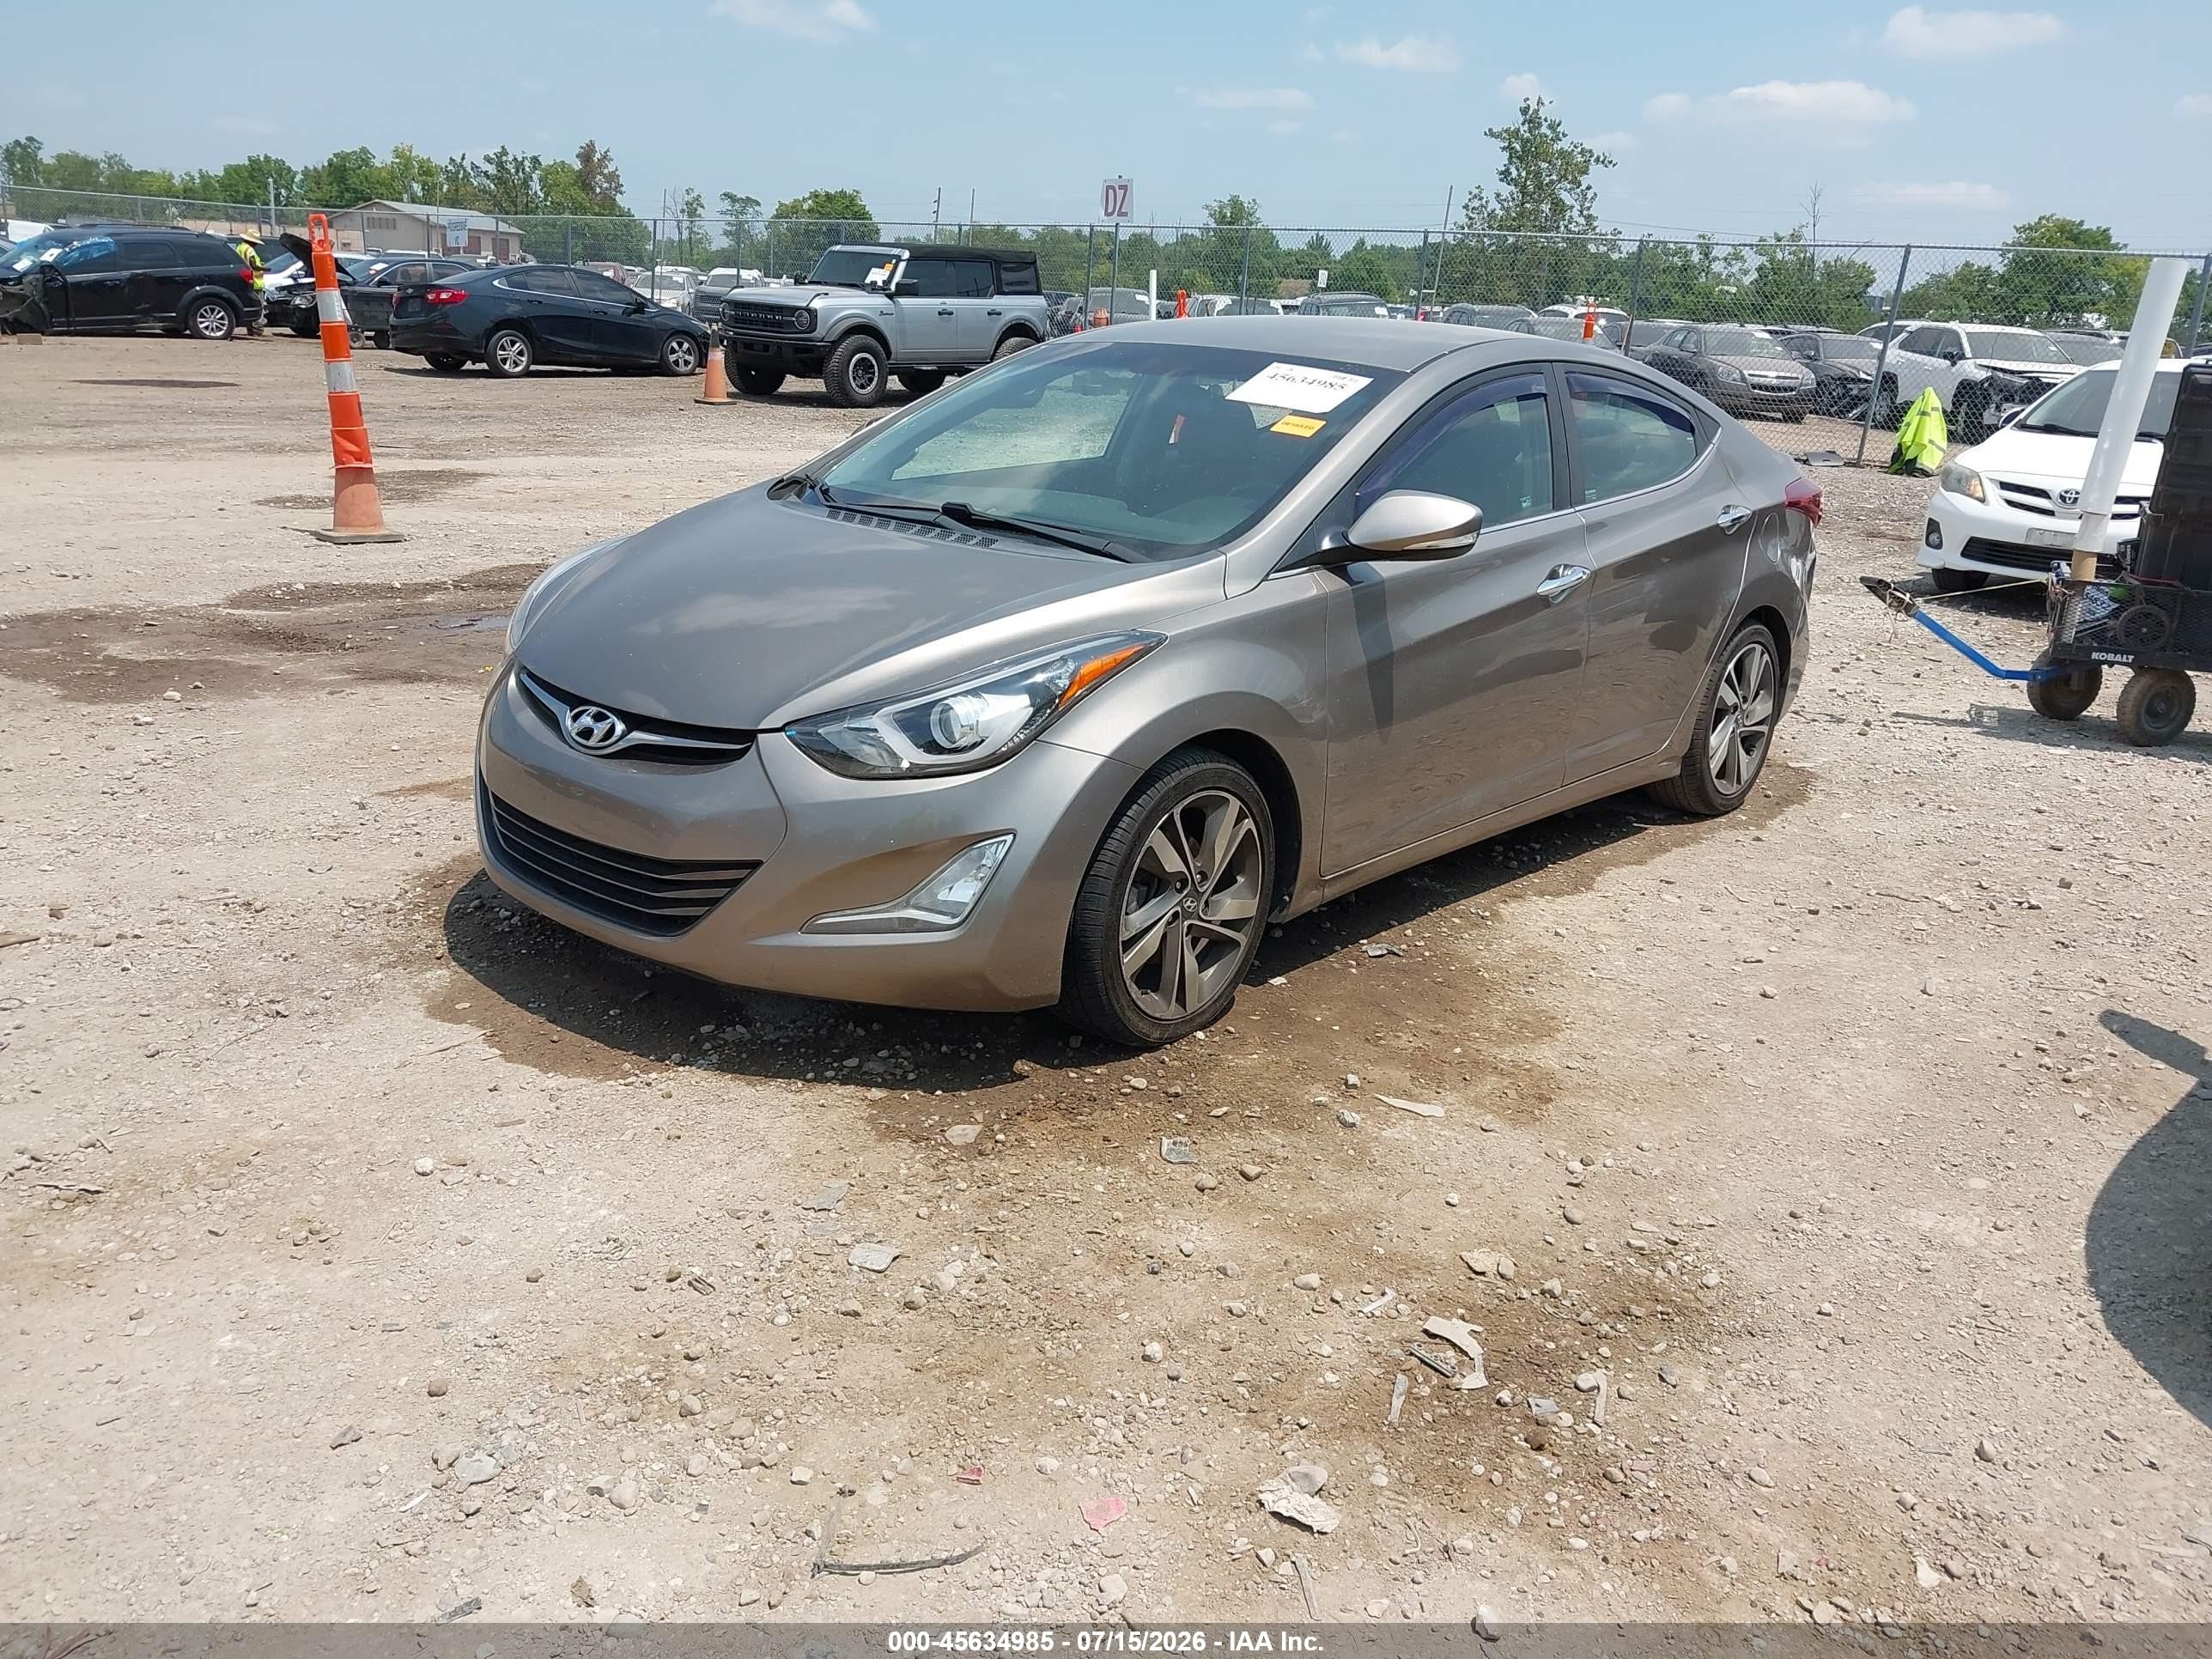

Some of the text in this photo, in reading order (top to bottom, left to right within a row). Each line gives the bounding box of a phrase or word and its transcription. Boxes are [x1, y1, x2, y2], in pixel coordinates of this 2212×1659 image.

[1104, 185, 1127, 216] DZ
[1267, 373, 1348, 391] 45634985
[2091, 652, 2135, 663] KOBALT
